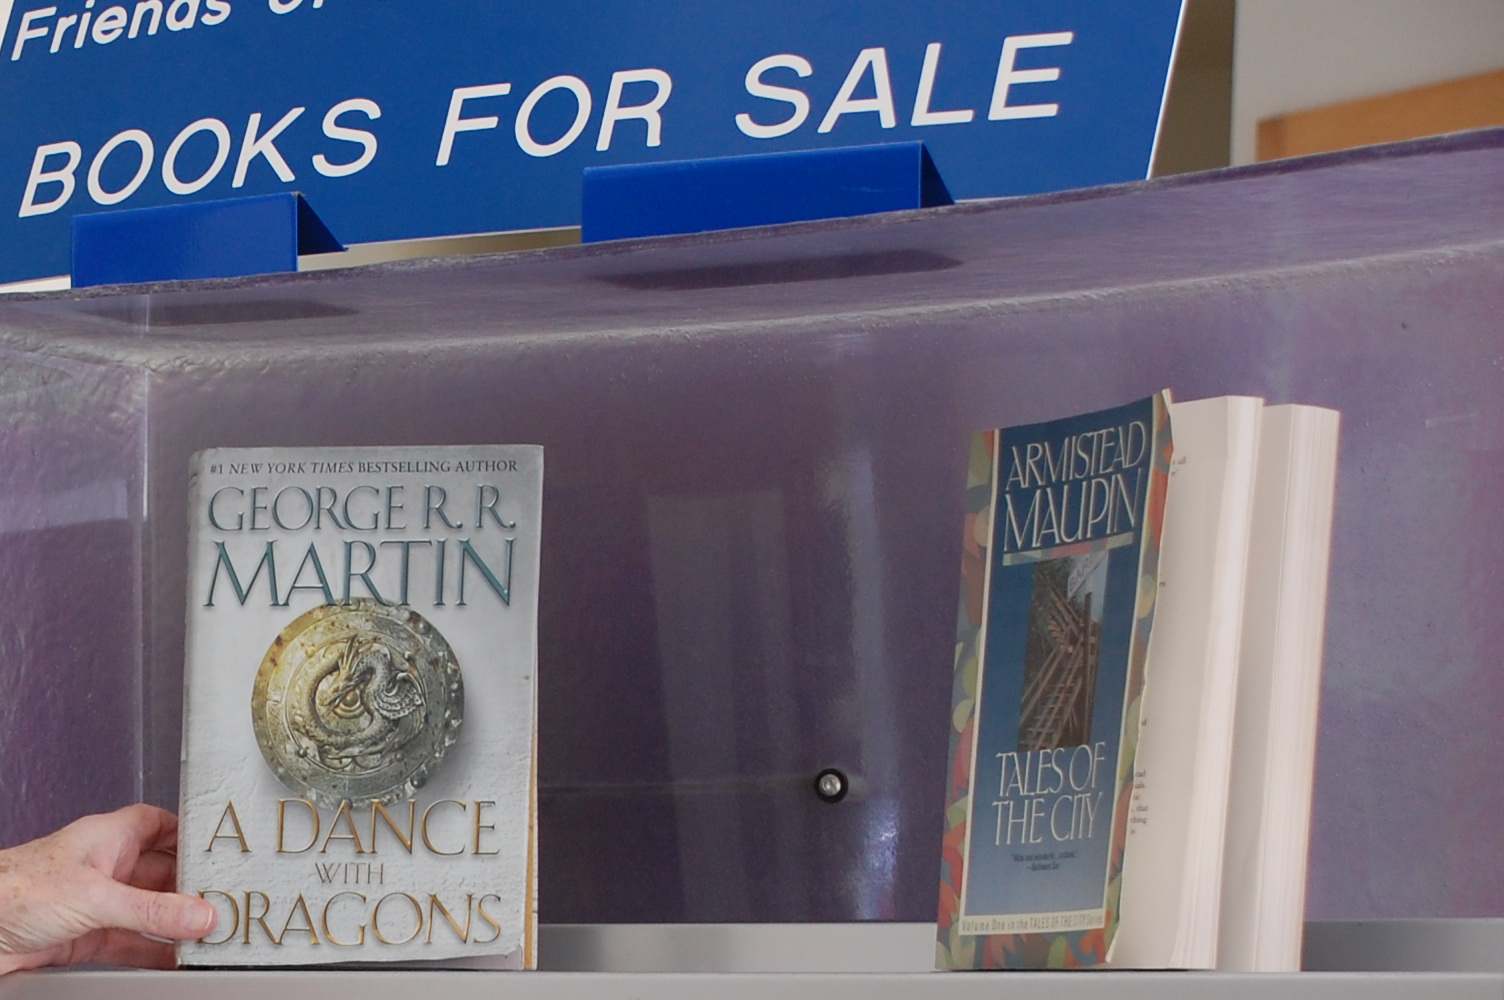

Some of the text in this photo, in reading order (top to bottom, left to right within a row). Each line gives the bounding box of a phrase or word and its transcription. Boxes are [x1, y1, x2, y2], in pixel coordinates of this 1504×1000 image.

[11, 0, 231, 61] Friends
[18, 31, 1073, 217] BOOKS FOR SALE
[209, 459, 519, 475] #1 NEW YORK TIMES BESTSELLING AUTHOR
[1005, 421, 1147, 491] ARMISTEAD
[207, 485, 408, 531] GEORGE
[1003, 467, 1144, 551] MAUPIN
[203, 538, 517, 608] MARTIN
[995, 748, 1066, 797] TALES
[1069, 742, 1105, 791] OF
[206, 798, 501, 856] A DANCE
[992, 791, 1103, 846] THE CITY
[314, 862, 385, 885] WITH
[197, 889, 502, 946] DRAGONS
[961, 920, 990, 932] Volume
[992, 918, 1005, 931] One
[1017, 918, 1029, 930] the
[1030, 917, 1049, 929] TALES
